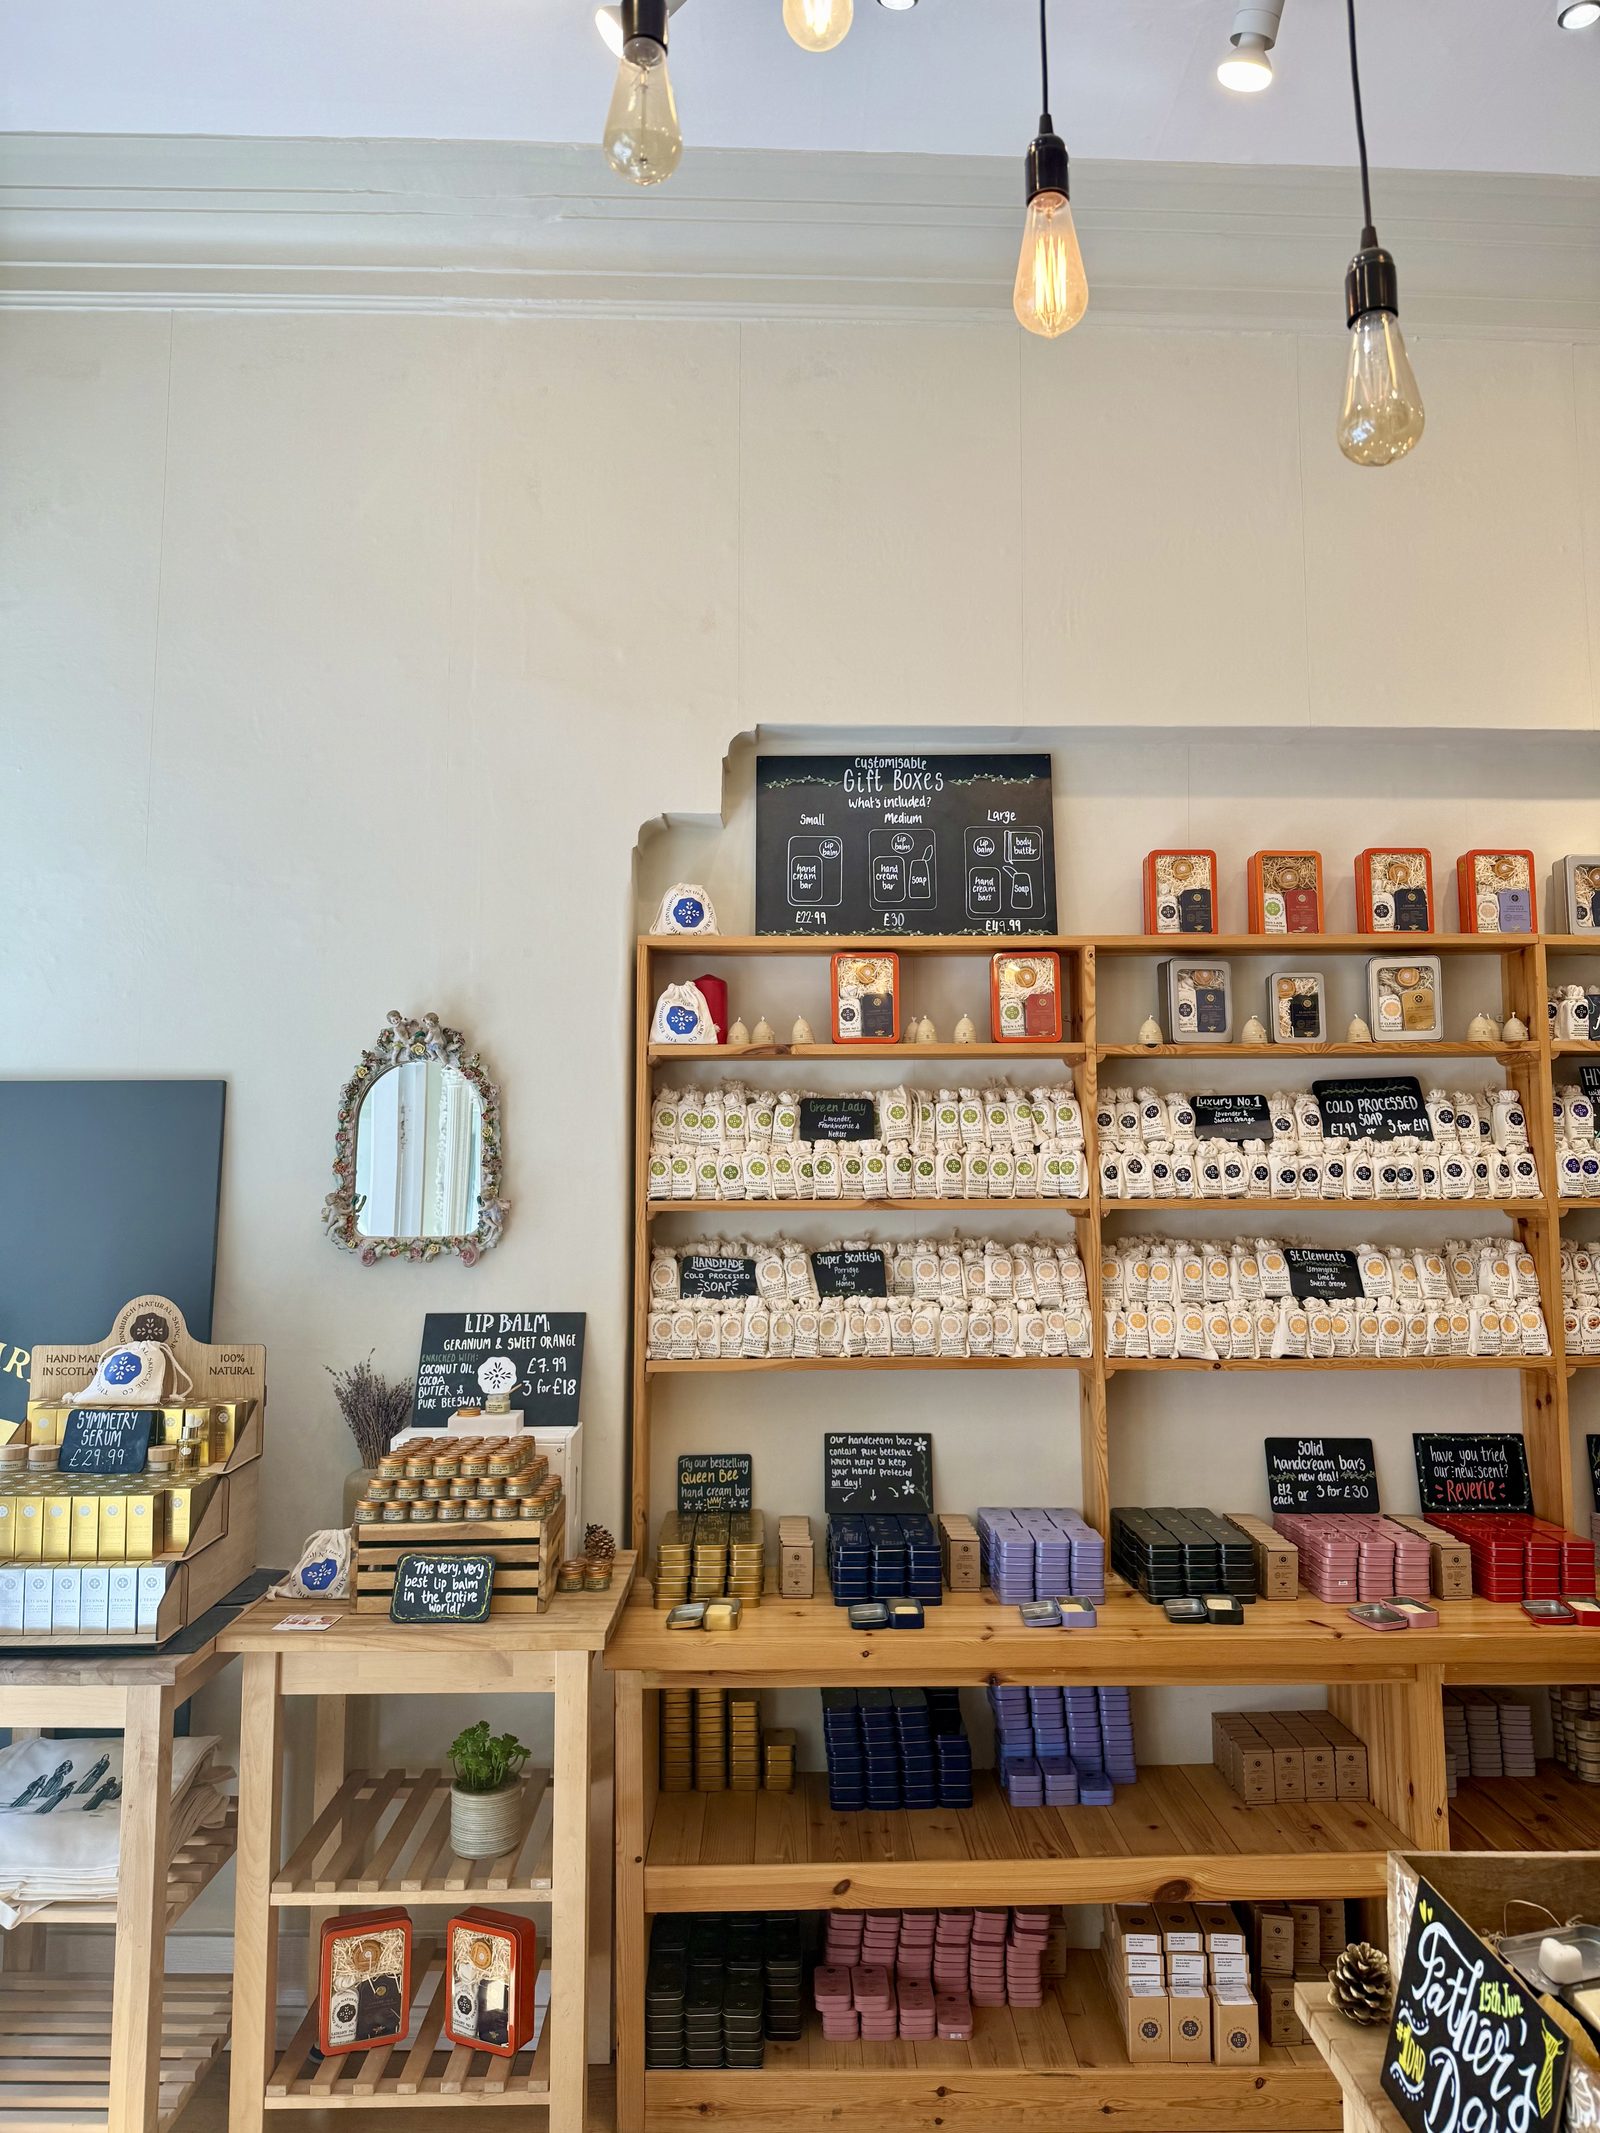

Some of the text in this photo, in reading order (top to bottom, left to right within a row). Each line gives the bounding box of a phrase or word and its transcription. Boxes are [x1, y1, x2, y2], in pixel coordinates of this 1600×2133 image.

[843, 768, 944, 793] Gift Boxes
[883, 795, 932, 809] included?
[799, 813, 825, 826] Small
[884, 812, 923, 825] Medium
[987, 809, 1017, 823] Large
[1015, 836, 1032, 847] body
[1013, 845, 1037, 855] butter
[796, 863, 817, 873] hand
[880, 863, 899, 873] hand
[792, 872, 817, 881] cream
[875, 872, 899, 881] cream
[975, 876, 994, 887] hand
[799, 880, 813, 890] bar
[882, 880, 895, 890] bar
[972, 885, 996, 894] cream
[977, 892, 992, 901] bars
[883, 912, 905, 927] £30
[985, 919, 1021, 933] £49.99
[809, 1100, 867, 1117] Green Lady
[1196, 1096, 1233, 1110] Luxury
[1325, 1095, 1418, 1114] COLD PROCESSED
[1213, 1116, 1233, 1124] Sweet
[1215, 1110, 1242, 1118] Lavender
[1358, 1112, 1383, 1127] SOAP
[1331, 1121, 1358, 1136] £7.99
[1366, 1127, 1377, 1135] or
[1387, 1119, 1396, 1134] 3
[1397, 1119, 1412, 1134] for
[1413, 1118, 1430, 1132] £19
[692, 1256, 745, 1270] HANDMADE
[816, 1251, 882, 1269] Super Scottish
[1302, 1250, 1346, 1263] Clements
[683, 1271, 750, 1280] COLD PROCESSED
[834, 1266, 860, 1278] Porridge
[703, 1281, 731, 1293] SOAP
[835, 1279, 856, 1290] Honey
[138, 1300, 173, 1316] NATURAL
[464, 1313, 550, 1333] LIP BALM
[443, 1333, 577, 1351] GERANIUM & SWEET ORANGE
[46, 1354, 76, 1363] HAND
[219, 1353, 245, 1363] 100%
[42, 1367, 55, 1376] IN
[209, 1366, 256, 1376] NATURAL
[420, 1363, 457, 1375] COCONUT
[526, 1356, 567, 1375] £7.99
[418, 1375, 446, 1386] COCOA
[522, 1377, 577, 1396] 3 for £18
[418, 1385, 452, 1399] BUTTER
[417, 1397, 437, 1410] PURE
[441, 1396, 482, 1408] BEESWAX
[76, 1410, 139, 1430] SYMMETRY
[81, 1429, 122, 1448] SERUM
[829, 1436, 847, 1445] Our
[895, 1435, 913, 1445] bars
[829, 1447, 913, 1457] contain pure beeswax
[1297, 1439, 1324, 1456] Solid
[68, 1448, 125, 1467] £29.99
[877, 1457, 886, 1465] to
[888, 1458, 907, 1468] keep
[1273, 1454, 1366, 1471] handcream bars
[1429, 1444, 1508, 1467] have you tried
[680, 1456, 749, 1474] Try our bestselling
[1433, 1463, 1509, 1479] our new scent?
[681, 1469, 739, 1485] Queen Bee
[831, 1467, 913, 1478] your hands protected
[1298, 1471, 1339, 1482] new deal!
[681, 1484, 750, 1498] hand cream bar
[843, 1478, 862, 1490] day!
[1446, 1479, 1497, 1503] Reverie
[1277, 1483, 1369, 1500] £12 or 3 for £30
[1272, 1495, 1295, 1506] each
[437, 1562, 461, 1578] very,
[463, 1562, 485, 1580] very
[404, 1575, 428, 1588] best
[452, 1577, 478, 1590] balm
[403, 1588, 478, 1604] in the entire
[1479, 1981, 1501, 2016] 15th
[1405, 2037, 1426, 2085] DAD
